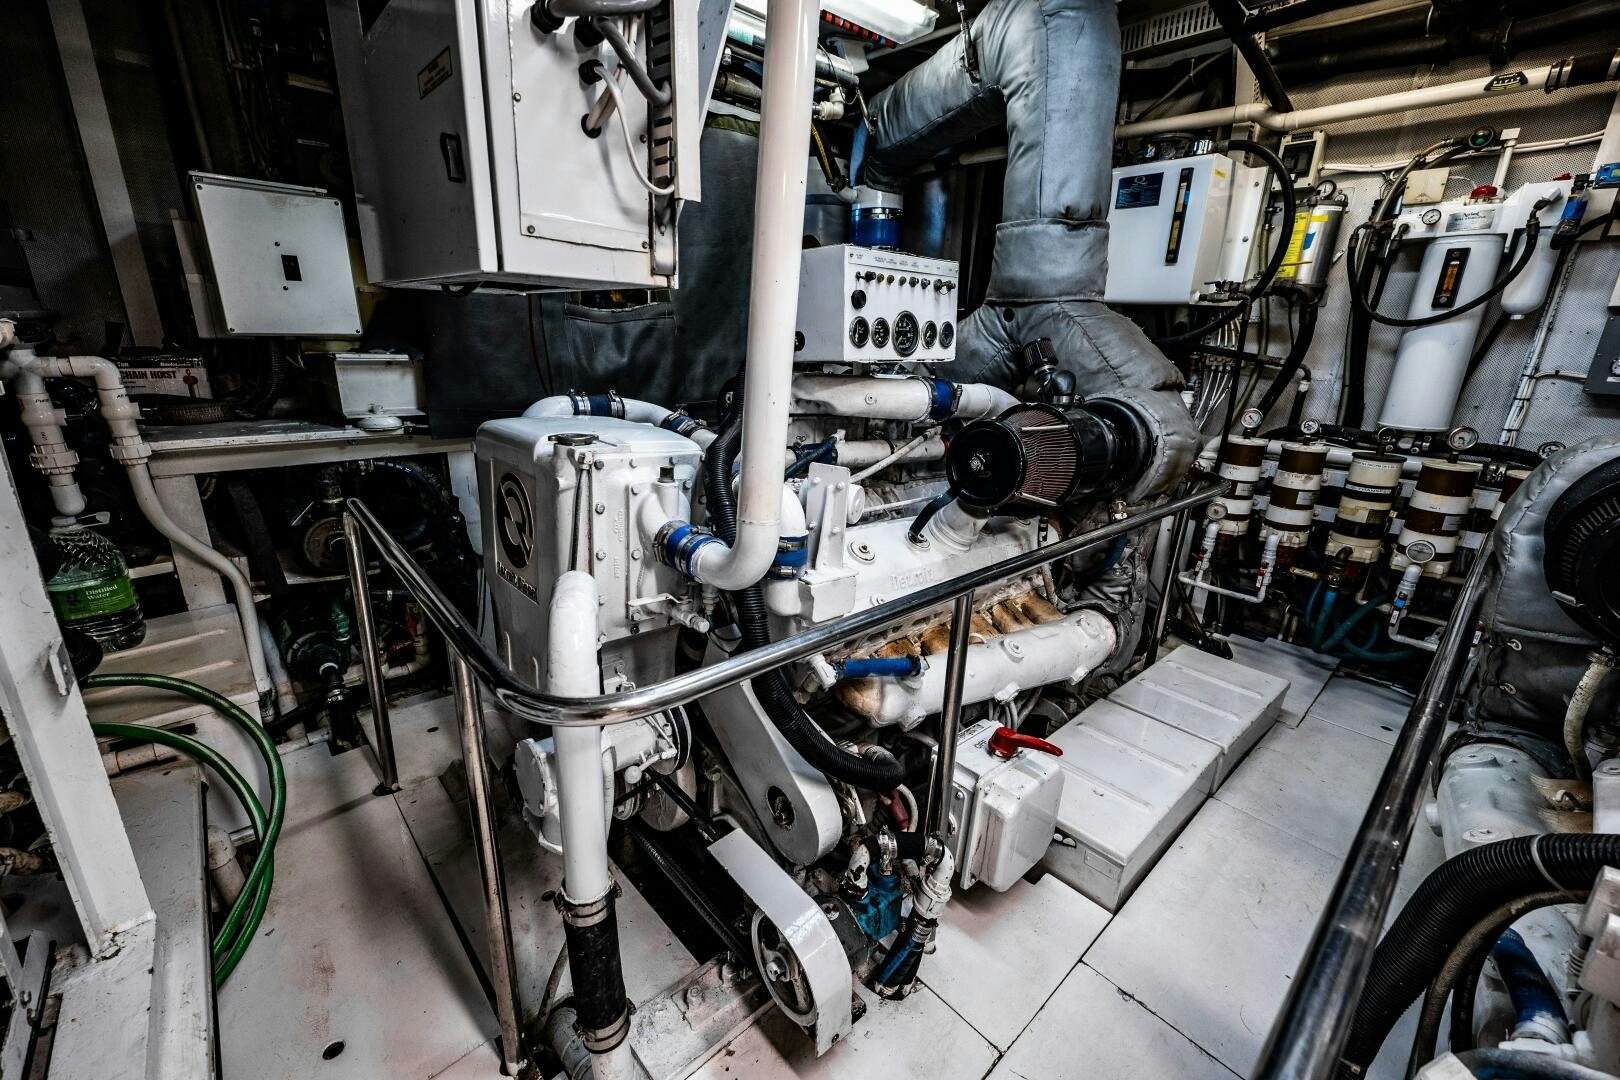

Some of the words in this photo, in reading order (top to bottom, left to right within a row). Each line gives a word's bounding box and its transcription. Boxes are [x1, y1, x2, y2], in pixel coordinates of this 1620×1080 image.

[149, 370, 177, 379] HOIST
[85, 583, 118, 596] Distilled
[87, 592, 111, 601] Water
